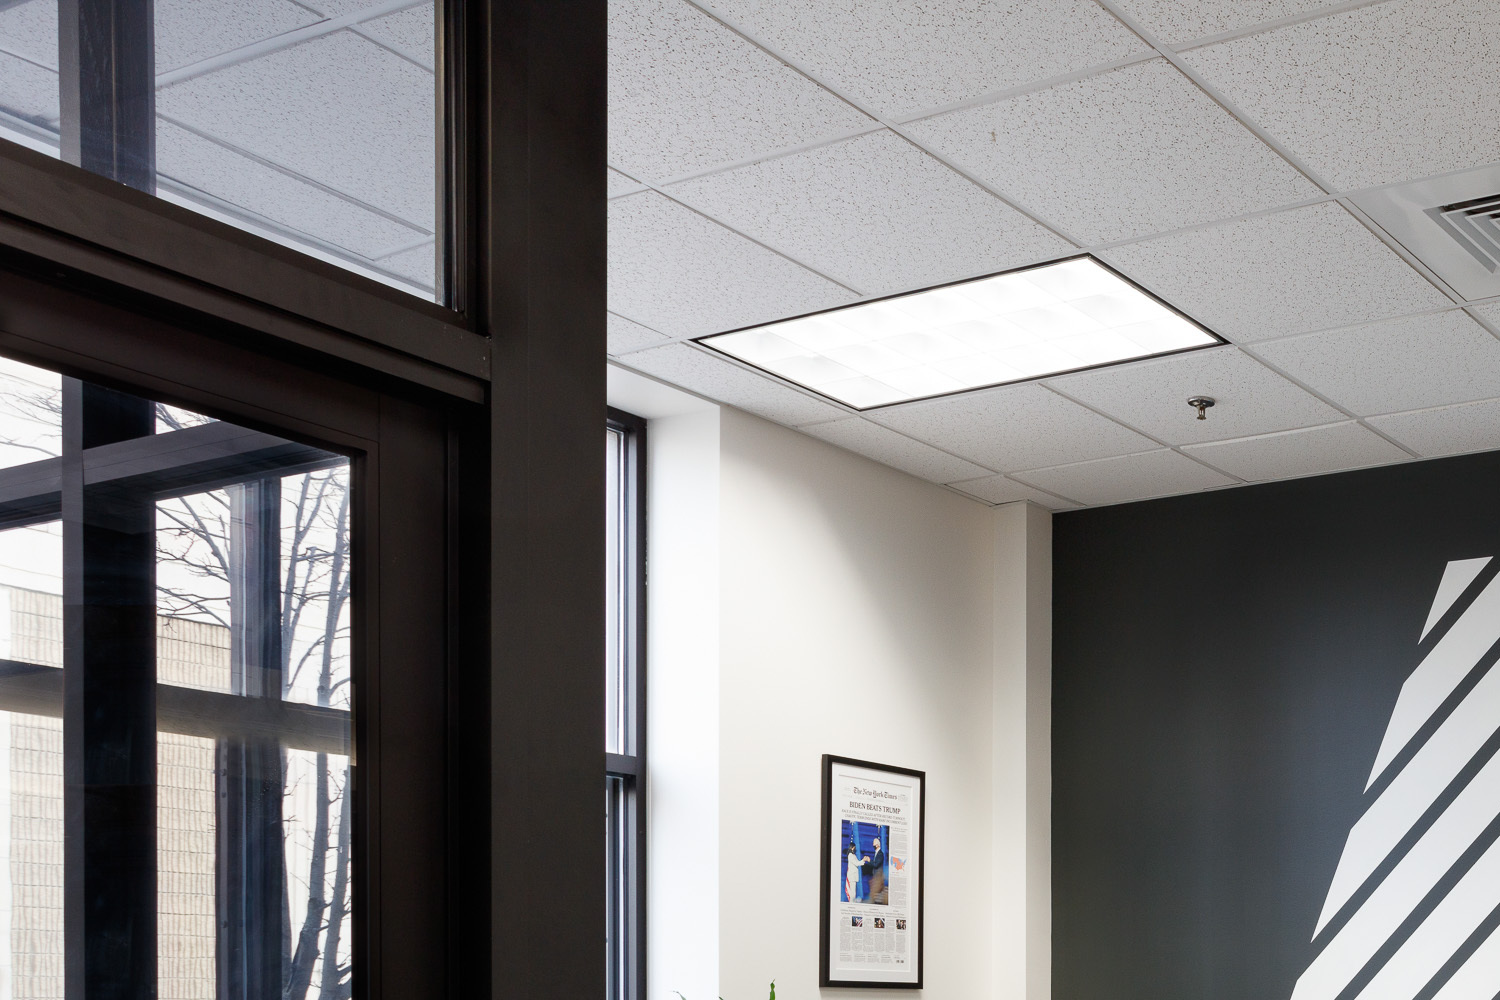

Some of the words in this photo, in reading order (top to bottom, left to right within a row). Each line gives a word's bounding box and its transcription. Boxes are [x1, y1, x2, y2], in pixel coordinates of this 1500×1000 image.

[862, 788, 872, 796] New
[873, 790, 883, 798] York
[884, 792, 897, 800] Times
[849, 801, 865, 809] BIDEN
[866, 803, 882, 812] BEATS
[883, 805, 901, 814] TRUMP
